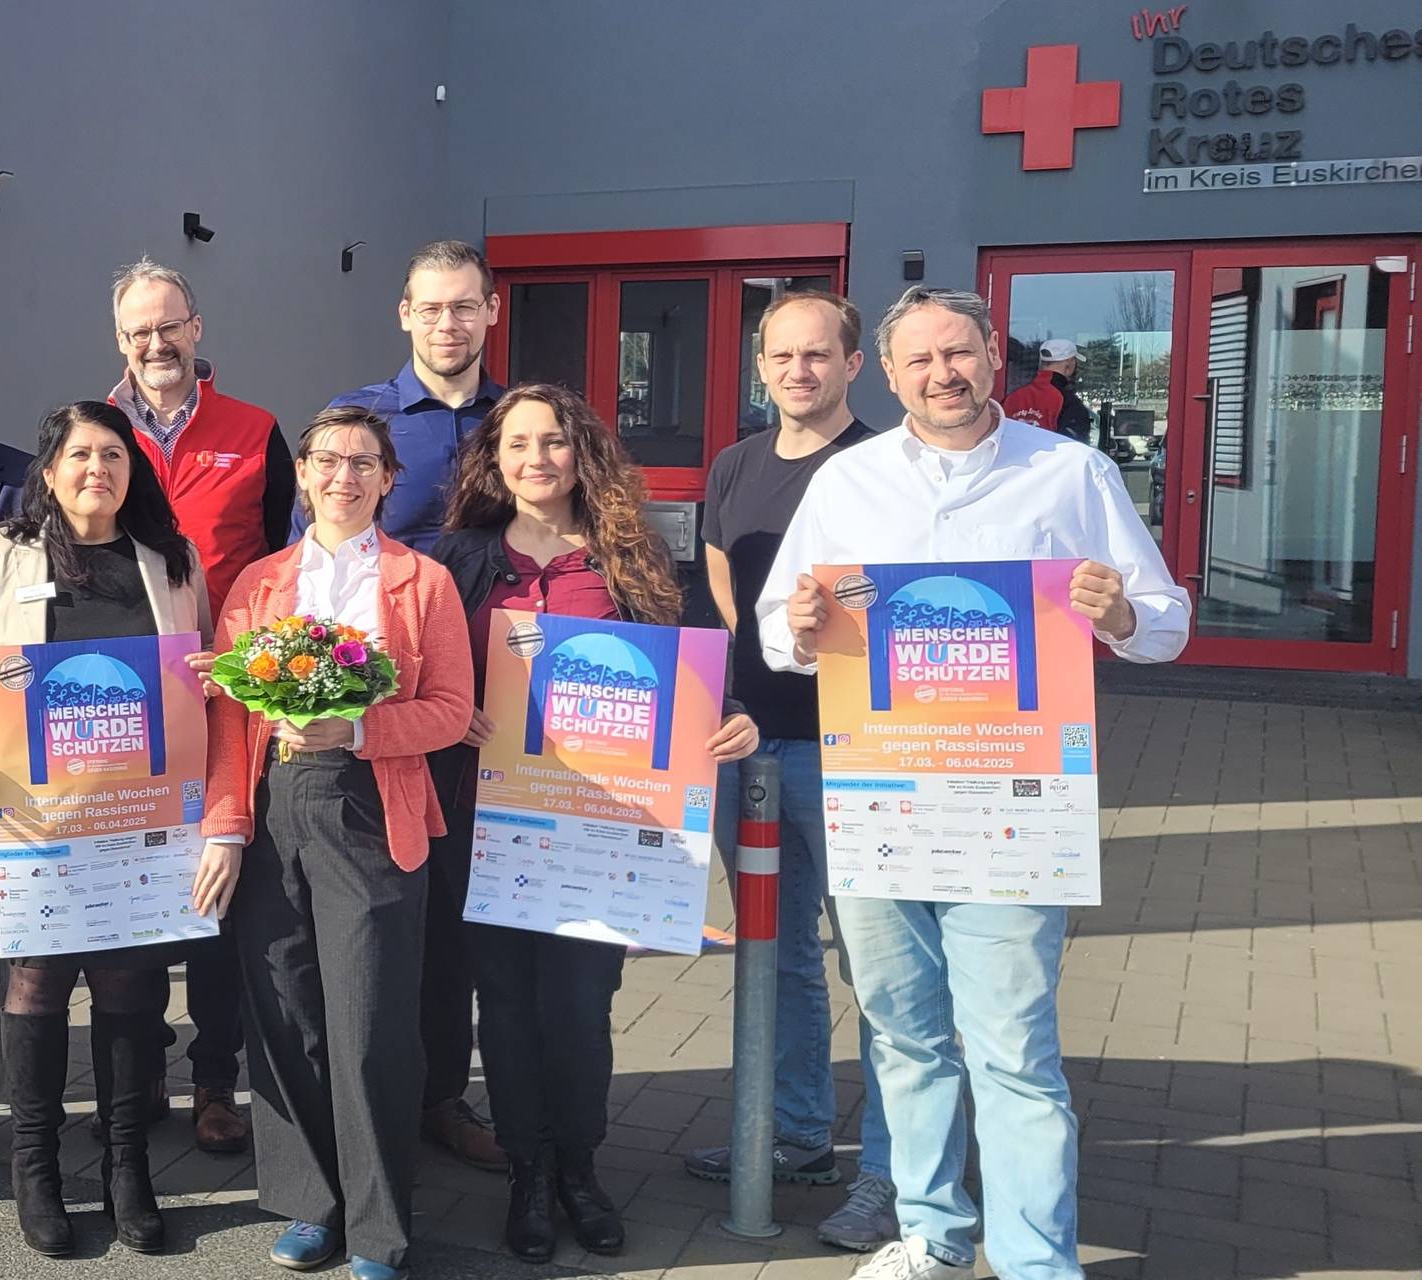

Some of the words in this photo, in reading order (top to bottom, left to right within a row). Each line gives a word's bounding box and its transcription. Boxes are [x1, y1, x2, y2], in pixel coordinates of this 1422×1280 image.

[1150, 80, 1306, 121] Rotes
[1147, 127, 1302, 166] Kreuz
[1147, 172, 1177, 189] im
[1190, 169, 1261, 188] Kreis
[1273, 160, 1422, 185] Euskirche
[894, 627, 1008, 642] MENSCHEN
[895, 641, 1010, 664] WÜRDE
[897, 664, 1010, 681] SCHÜTZEN
[552, 680, 652, 704] MENSCHEN
[49, 702, 141, 720] MENSCHEN
[552, 695, 650, 725] WÜRDE
[49, 717, 143, 741] WÜRDE
[551, 716, 648, 740] SCHÜTZEN
[864, 722, 971, 736] Internationale
[975, 723, 1043, 736] Wochen
[52, 736, 143, 756] SCHÜTZEN
[882, 740, 930, 753] gegen
[936, 740, 1025, 752] Rassismus
[898, 757, 934, 768] 17.03.
[946, 758, 1014, 768] 06.04.2025
[515, 763, 610, 785] Internationale
[613, 774, 671, 793] Wochen
[25, 791, 115, 808] Internationale
[117, 785, 169, 799] Wochen
[530, 780, 572, 797] gegen
[576, 786, 654, 806] Rassismus
[42, 808, 83, 822] gegen
[86, 802, 156, 817] Rassismus
[584, 802, 642, 819] 06.04.2025
[56, 824, 84, 834] 17.03.
[94, 816, 146, 831] 06.04.2025
